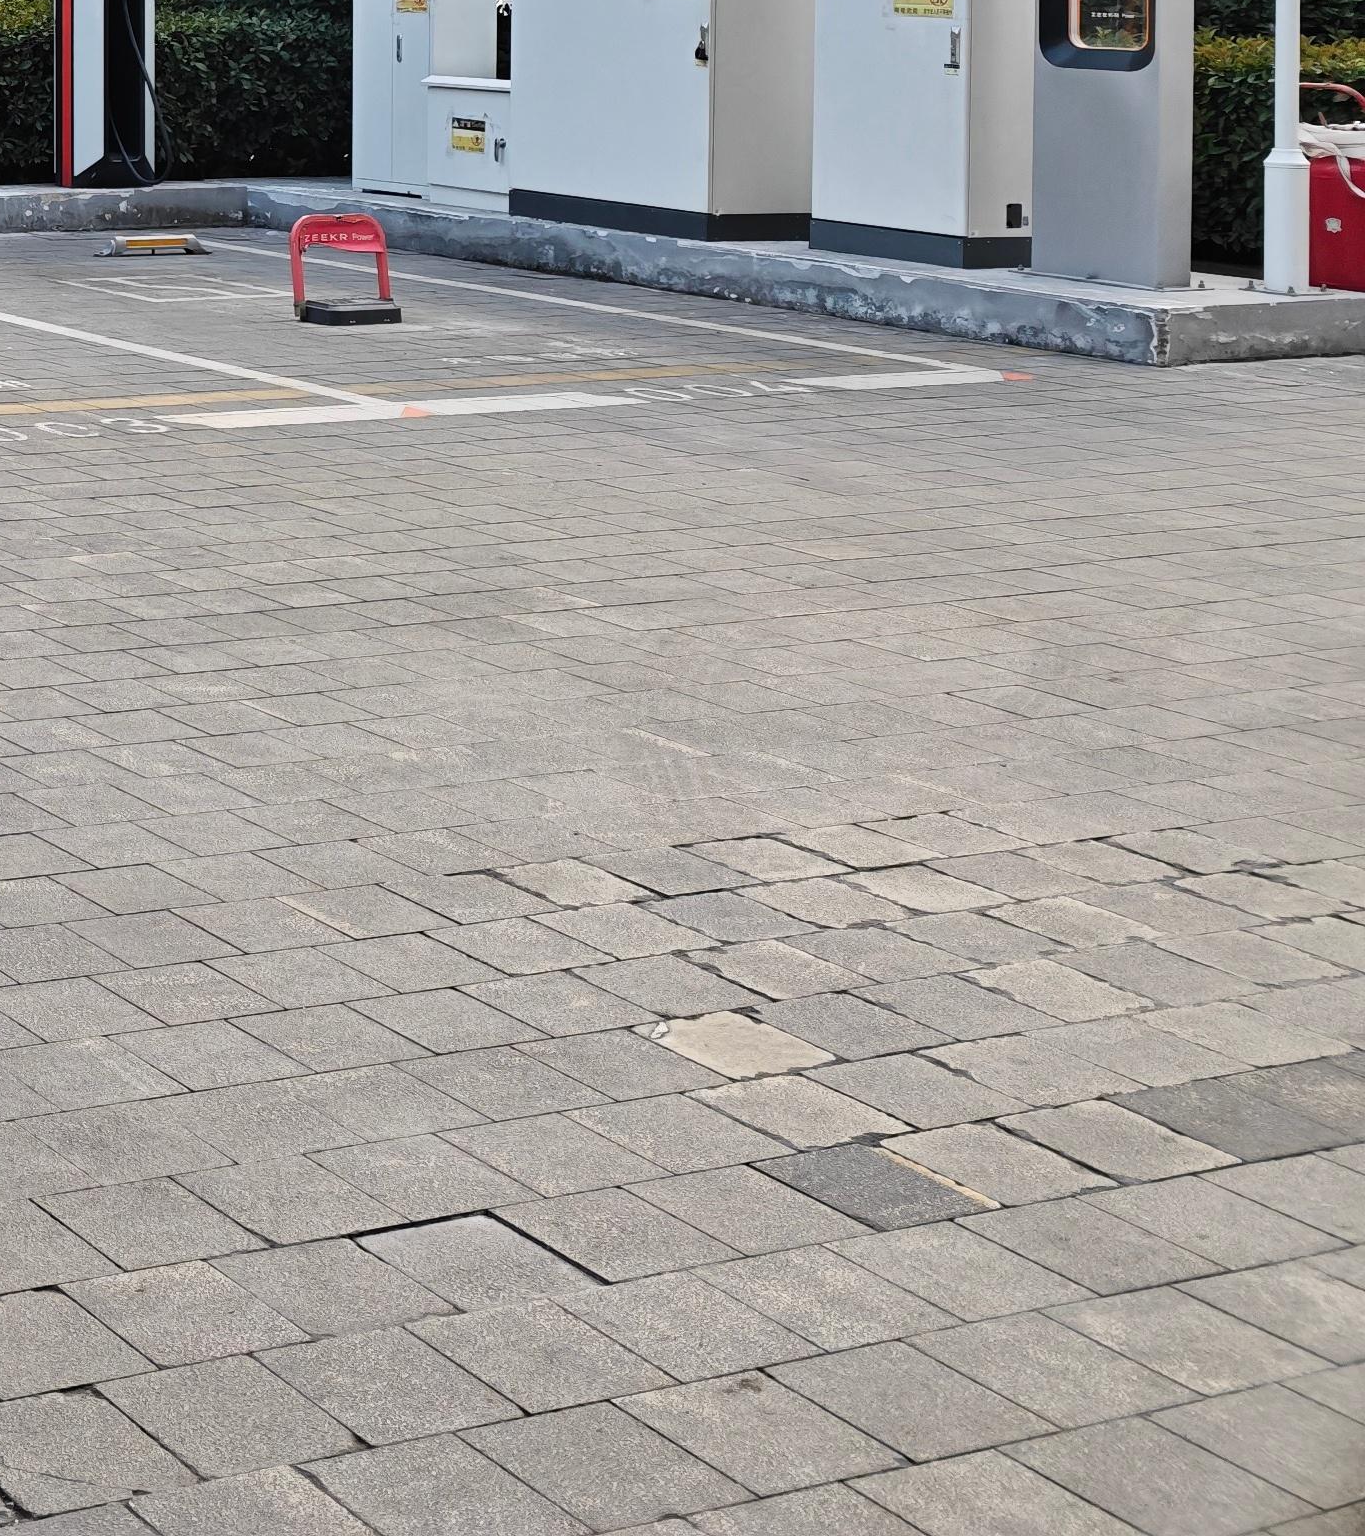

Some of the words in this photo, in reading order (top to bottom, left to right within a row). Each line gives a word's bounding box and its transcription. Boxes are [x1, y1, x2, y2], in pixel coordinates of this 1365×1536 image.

[304, 233, 349, 243] ZEEKR
[352, 233, 375, 241] Power
[624, 380, 812, 403] 004
